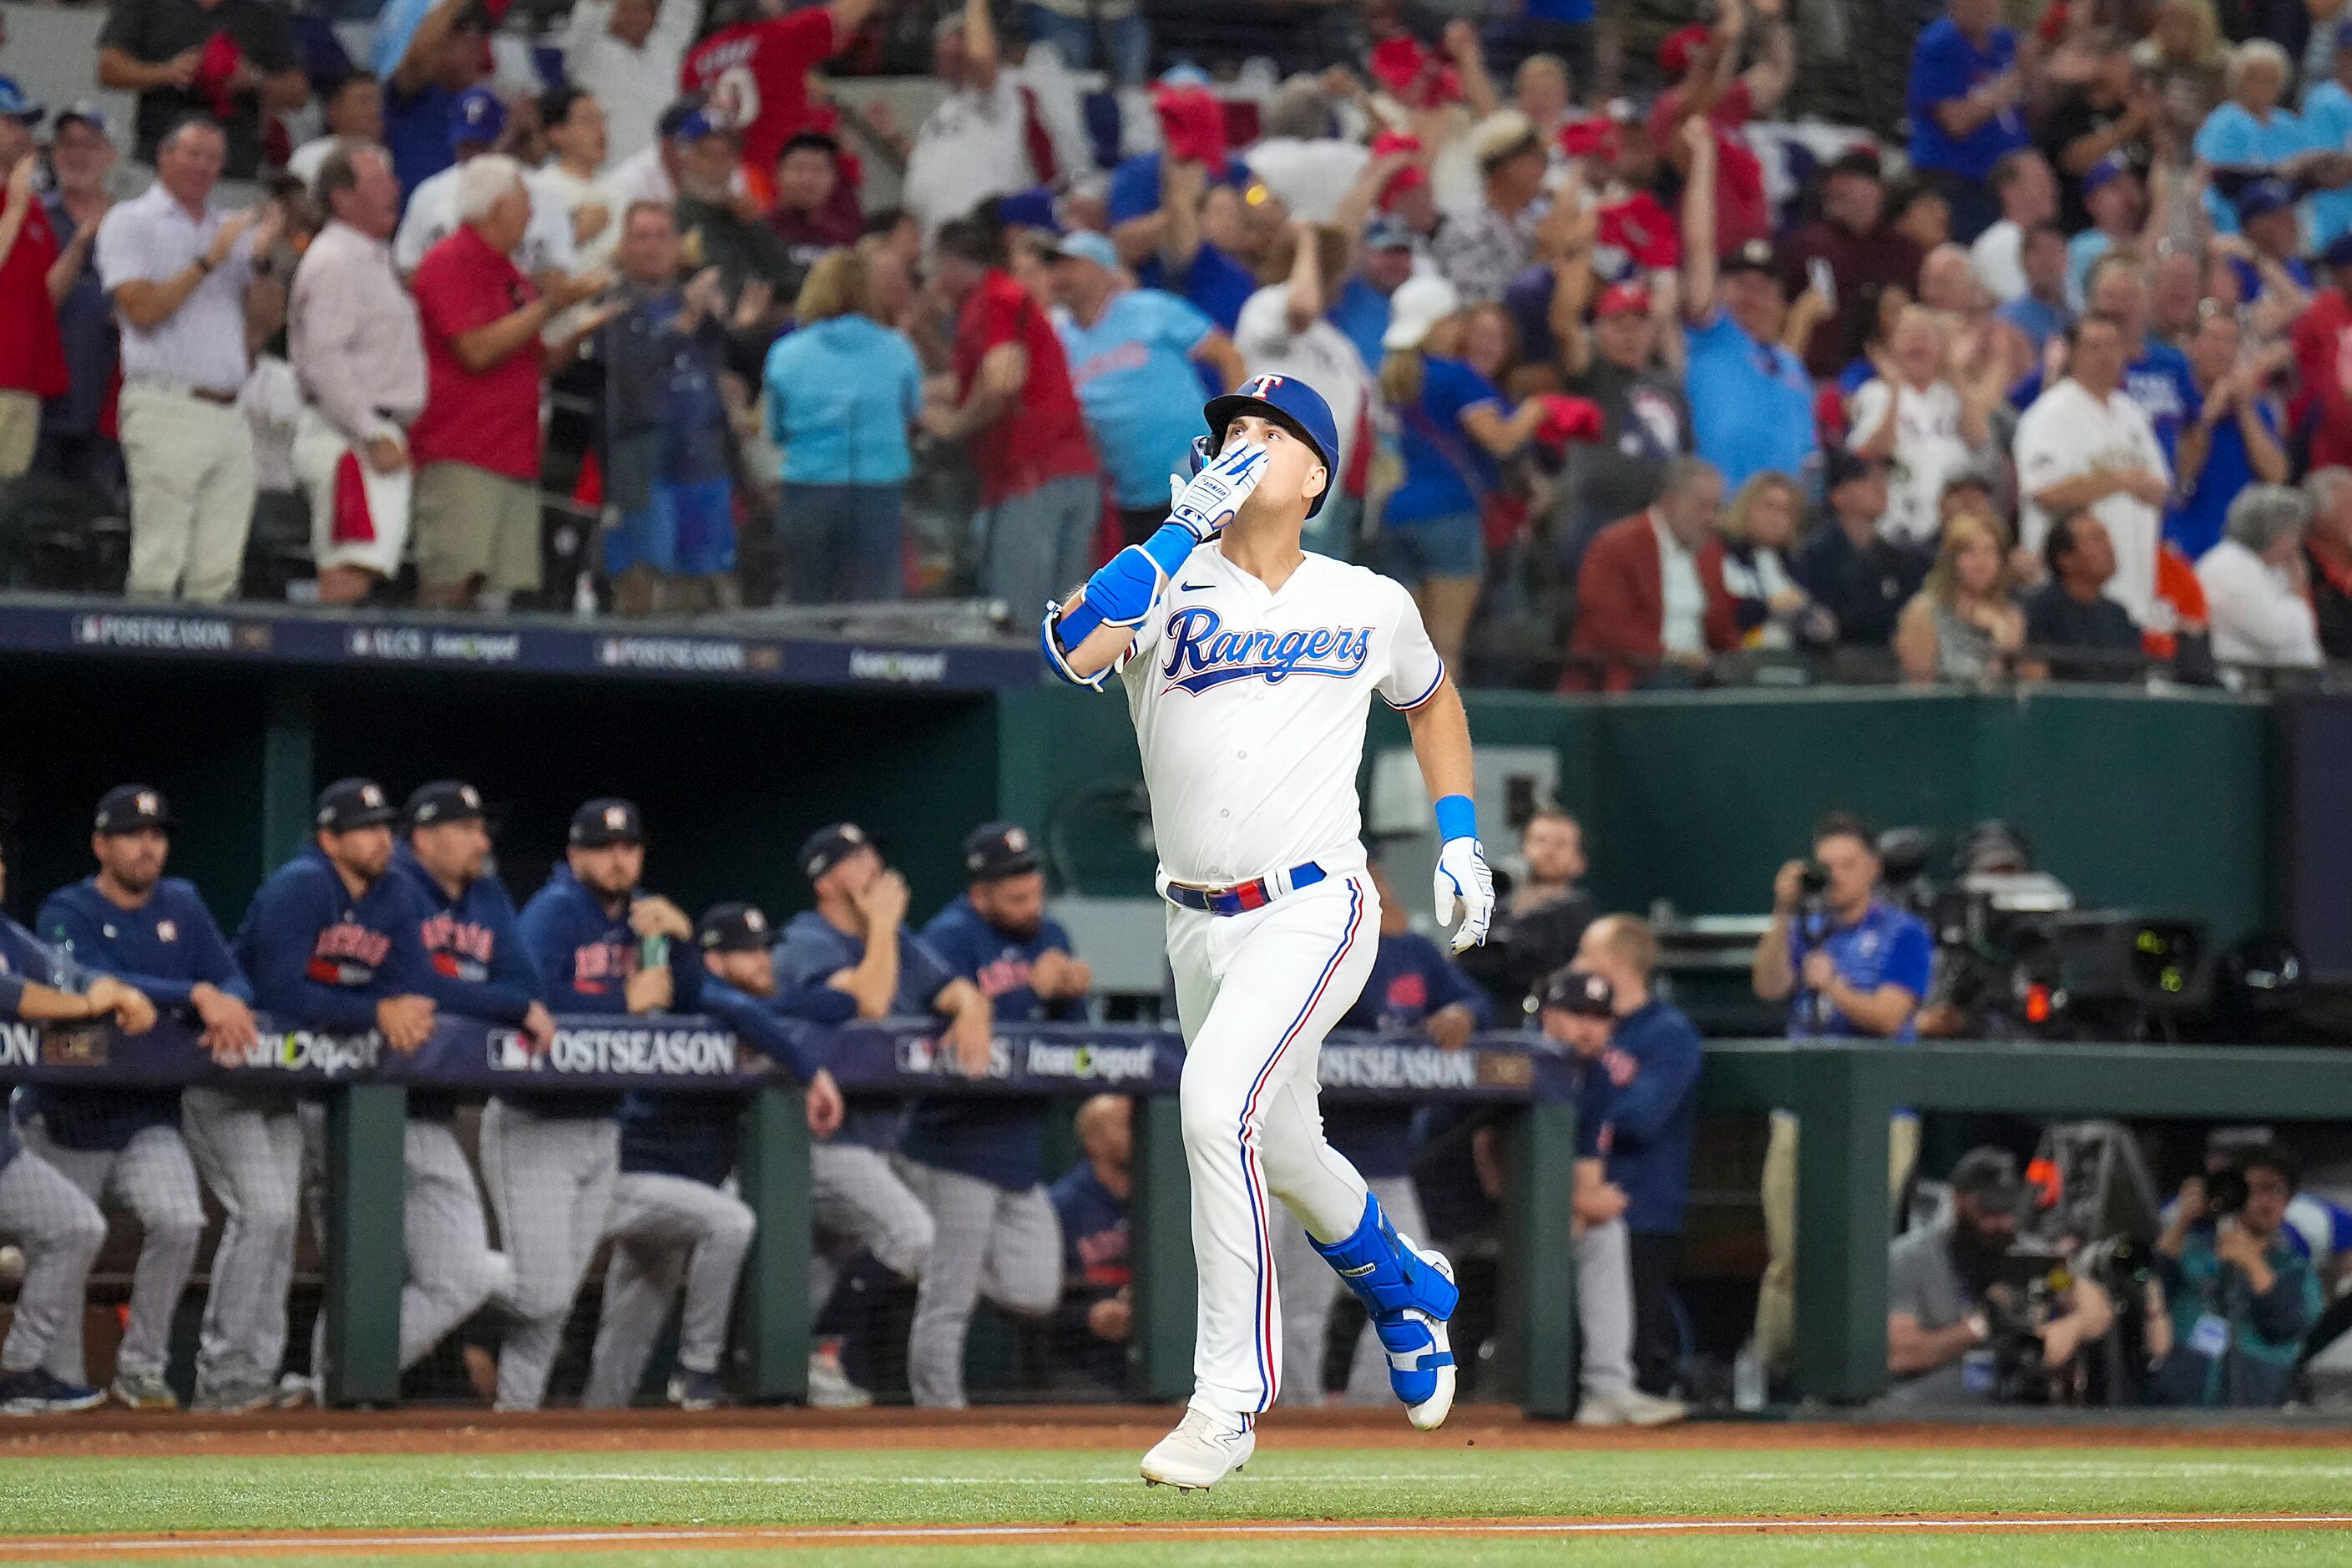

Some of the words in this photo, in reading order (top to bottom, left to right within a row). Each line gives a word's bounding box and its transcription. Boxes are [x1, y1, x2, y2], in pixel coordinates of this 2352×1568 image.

[1252, 375, 1283, 400] T
[1199, 478, 1227, 498] Franklin
[100, 616, 232, 650] POSTSEASON
[1161, 605, 1376, 690] Rangers
[529, 1029, 736, 1075] OSTSEASON
